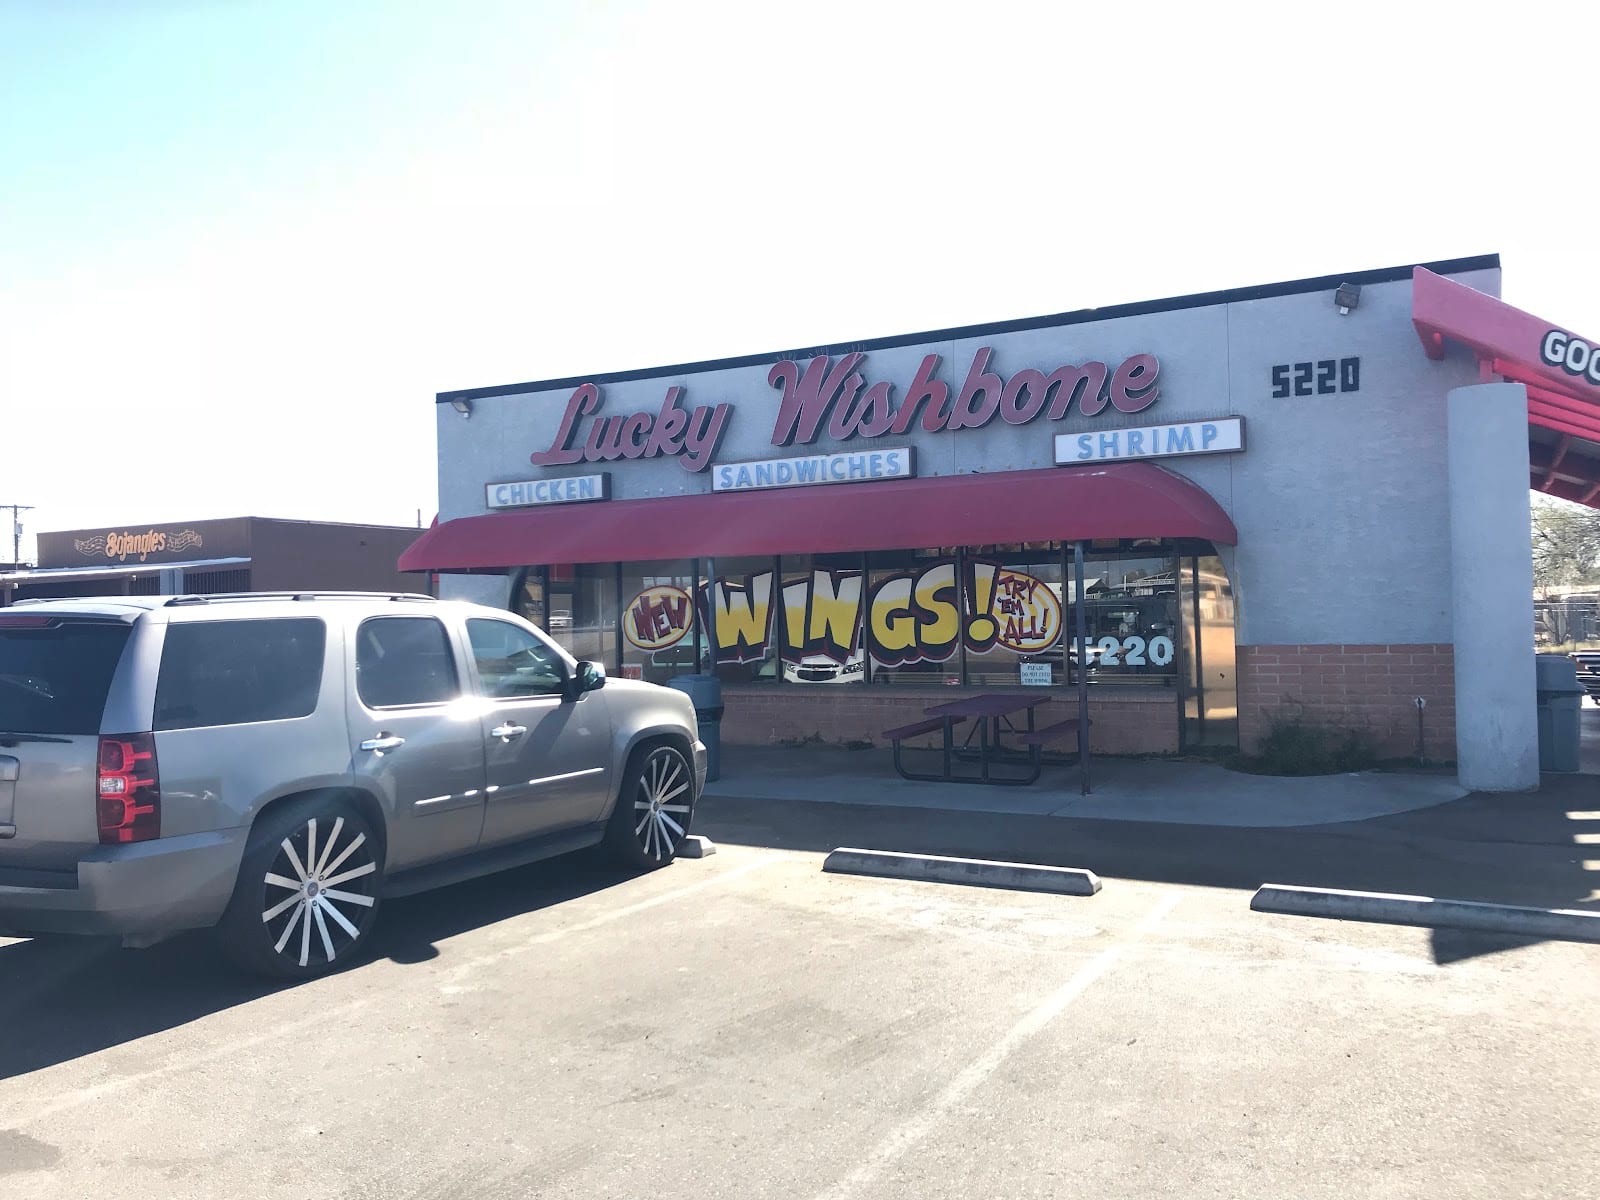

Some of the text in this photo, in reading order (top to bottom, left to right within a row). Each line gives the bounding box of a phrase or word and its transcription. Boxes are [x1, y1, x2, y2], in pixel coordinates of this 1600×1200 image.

[1272, 357, 1360, 398] 5220
[530, 346, 1161, 473] Lucky Wishbone
[1076, 423, 1219, 460] SHRIMP
[719, 451, 901, 489] SANDWICHES
[495, 476, 595, 506] CHICKEN
[104, 529, 167, 562] Bojangles
[702, 560, 998, 656] WINGS!
[998, 574, 1039, 605] TRY
[631, 595, 688, 643] NEW
[1003, 608, 1050, 645] ALL!
